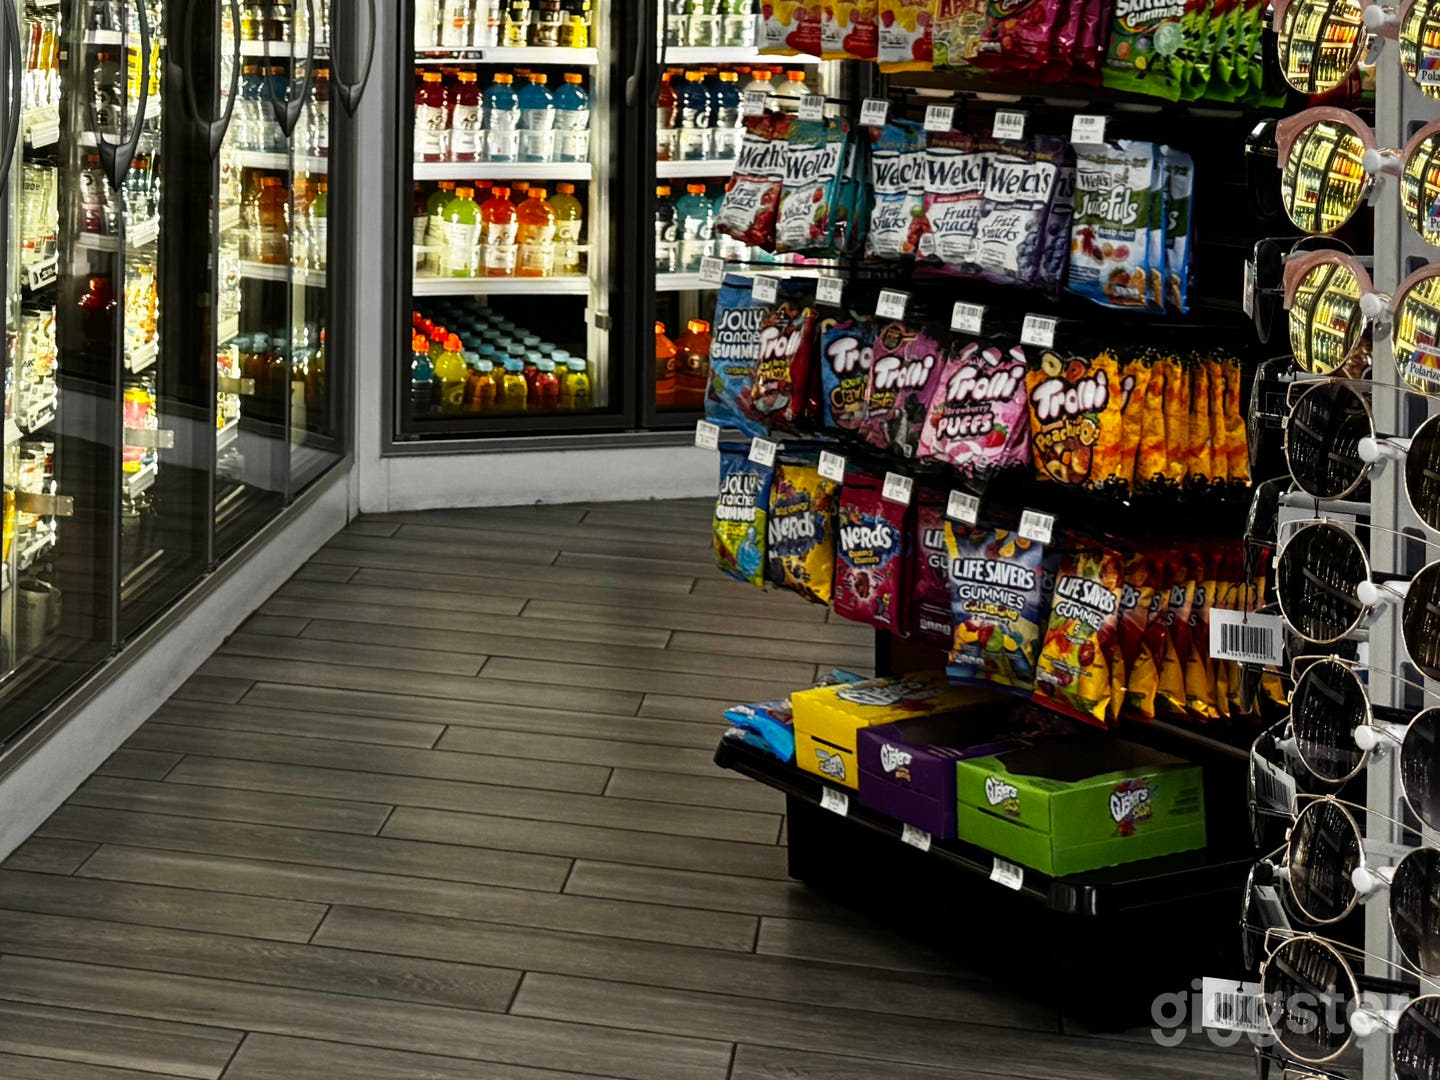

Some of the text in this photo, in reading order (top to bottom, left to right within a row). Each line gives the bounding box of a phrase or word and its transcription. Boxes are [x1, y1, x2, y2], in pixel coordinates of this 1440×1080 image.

[1126, 5, 1185, 27] Gummies
[944, 205, 977, 222] Fruit
[990, 214, 1021, 229] Fruit
[981, 226, 1020, 242] Snacks
[717, 309, 763, 331] JOLLY
[875, 356, 935, 389] Trolli
[945, 366, 1025, 402] Trolli
[1033, 369, 1109, 419] Trolli
[942, 404, 991, 416] Strawberry
[937, 413, 993, 439] PUFFS
[721, 472, 758, 495] JOLLY
[953, 557, 1035, 590] LIFE SAVERS
[959, 585, 1025, 610] GUMMIES
[1058, 576, 1117, 613] LIFE SAVERS
